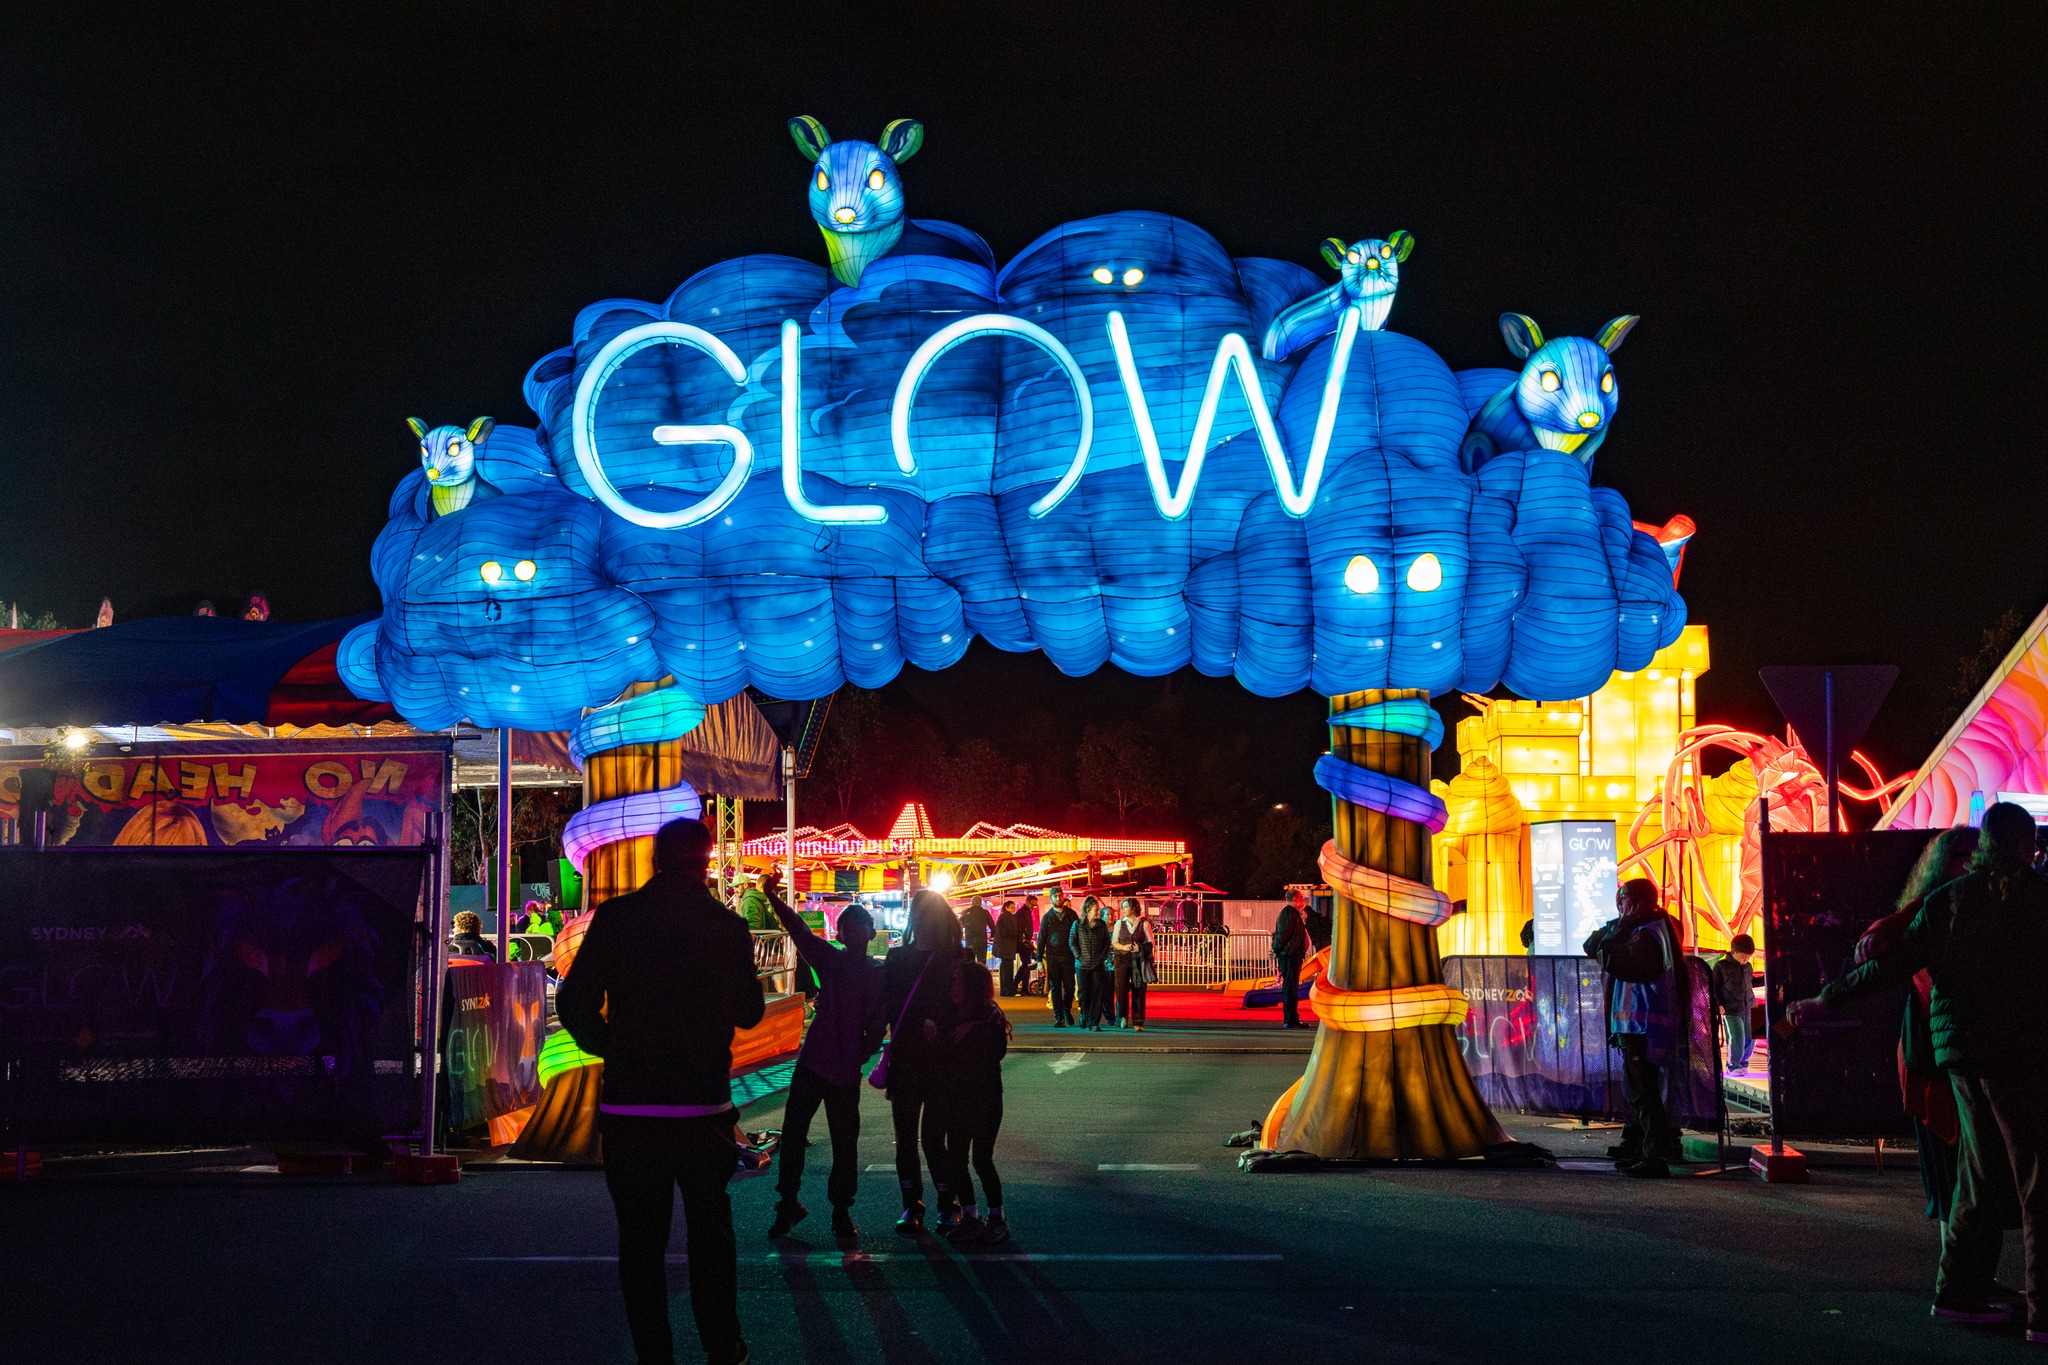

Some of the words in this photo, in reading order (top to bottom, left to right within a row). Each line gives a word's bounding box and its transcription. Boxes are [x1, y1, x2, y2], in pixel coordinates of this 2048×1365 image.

[572, 305, 1361, 529] GLOW
[1569, 837, 1611, 851] GLOW
[31, 926, 108, 941] SYDNEY
[1463, 988, 1505, 1001] SYDNEY
